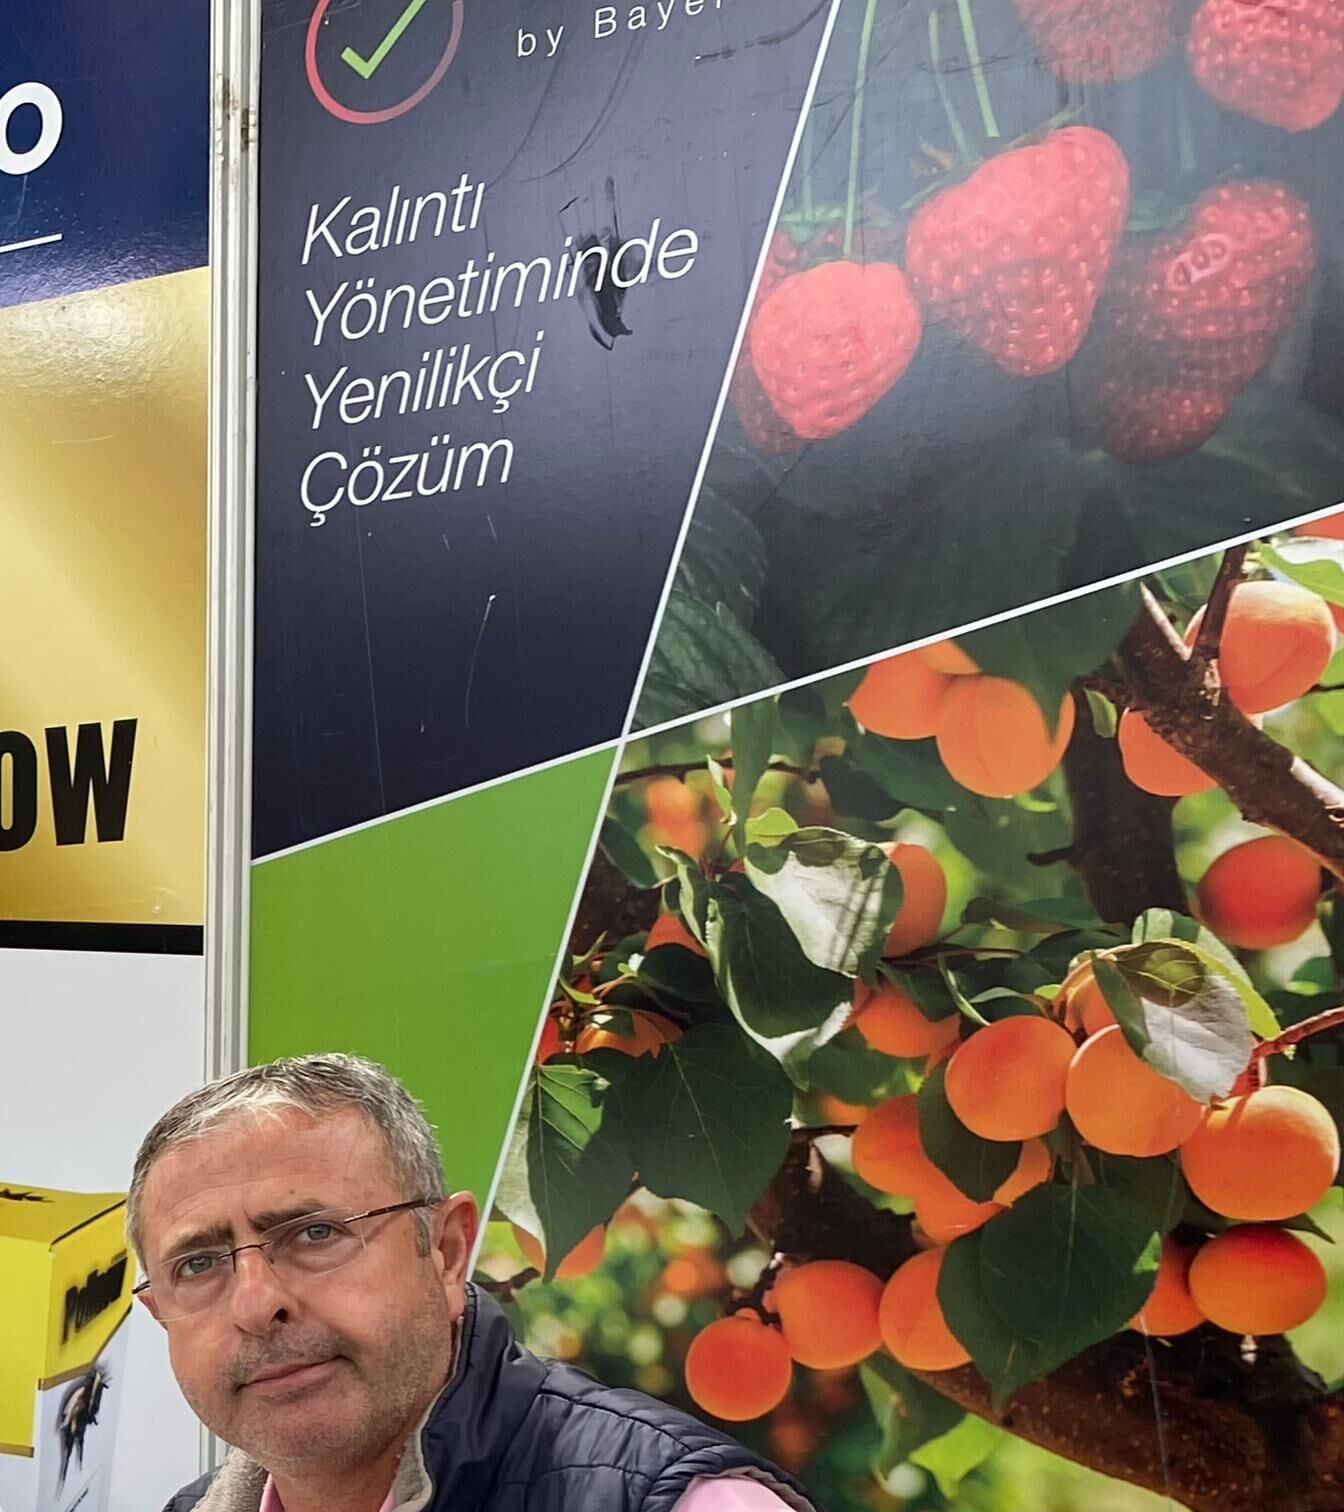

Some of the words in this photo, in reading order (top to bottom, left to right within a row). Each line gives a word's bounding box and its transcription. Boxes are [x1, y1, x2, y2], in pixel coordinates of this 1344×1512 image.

[517, 26, 565, 58] by
[301, 173, 485, 265] Kalıntı
[305, 218, 698, 347] Yönetiminde
[305, 330, 544, 430] Yenilikçi
[300, 435, 513, 526] Çözüm
